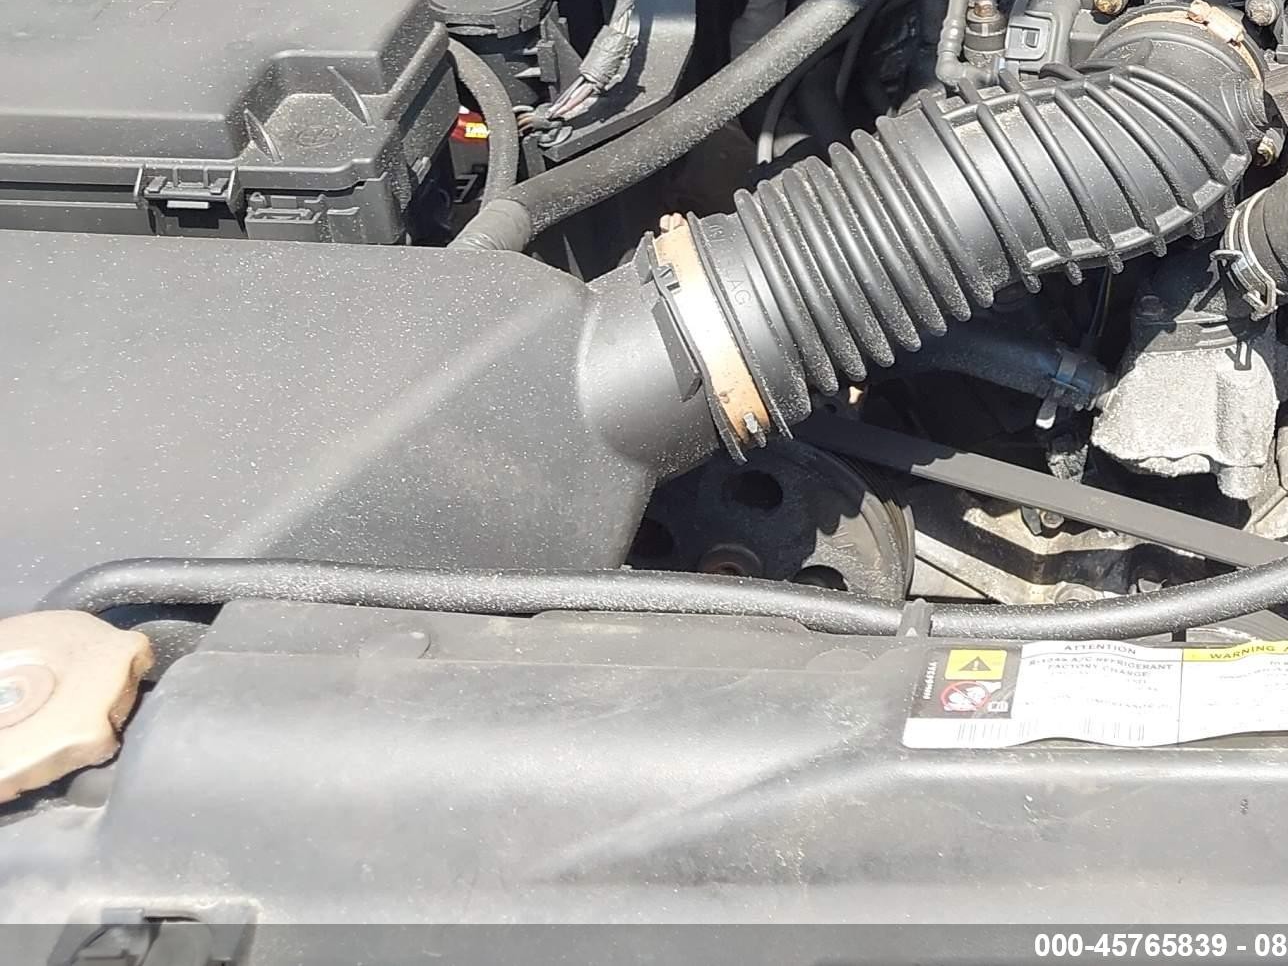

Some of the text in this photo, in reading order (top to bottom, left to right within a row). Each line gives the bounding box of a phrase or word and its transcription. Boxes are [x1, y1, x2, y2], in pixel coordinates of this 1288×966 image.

[1064, 644, 1137, 655] ATTENTION
[1210, 644, 1276, 660] WARNING
[1047, 663, 1150, 678] FACTORY CHARGE
[1095, 656, 1174, 671] REFRIGERANT
